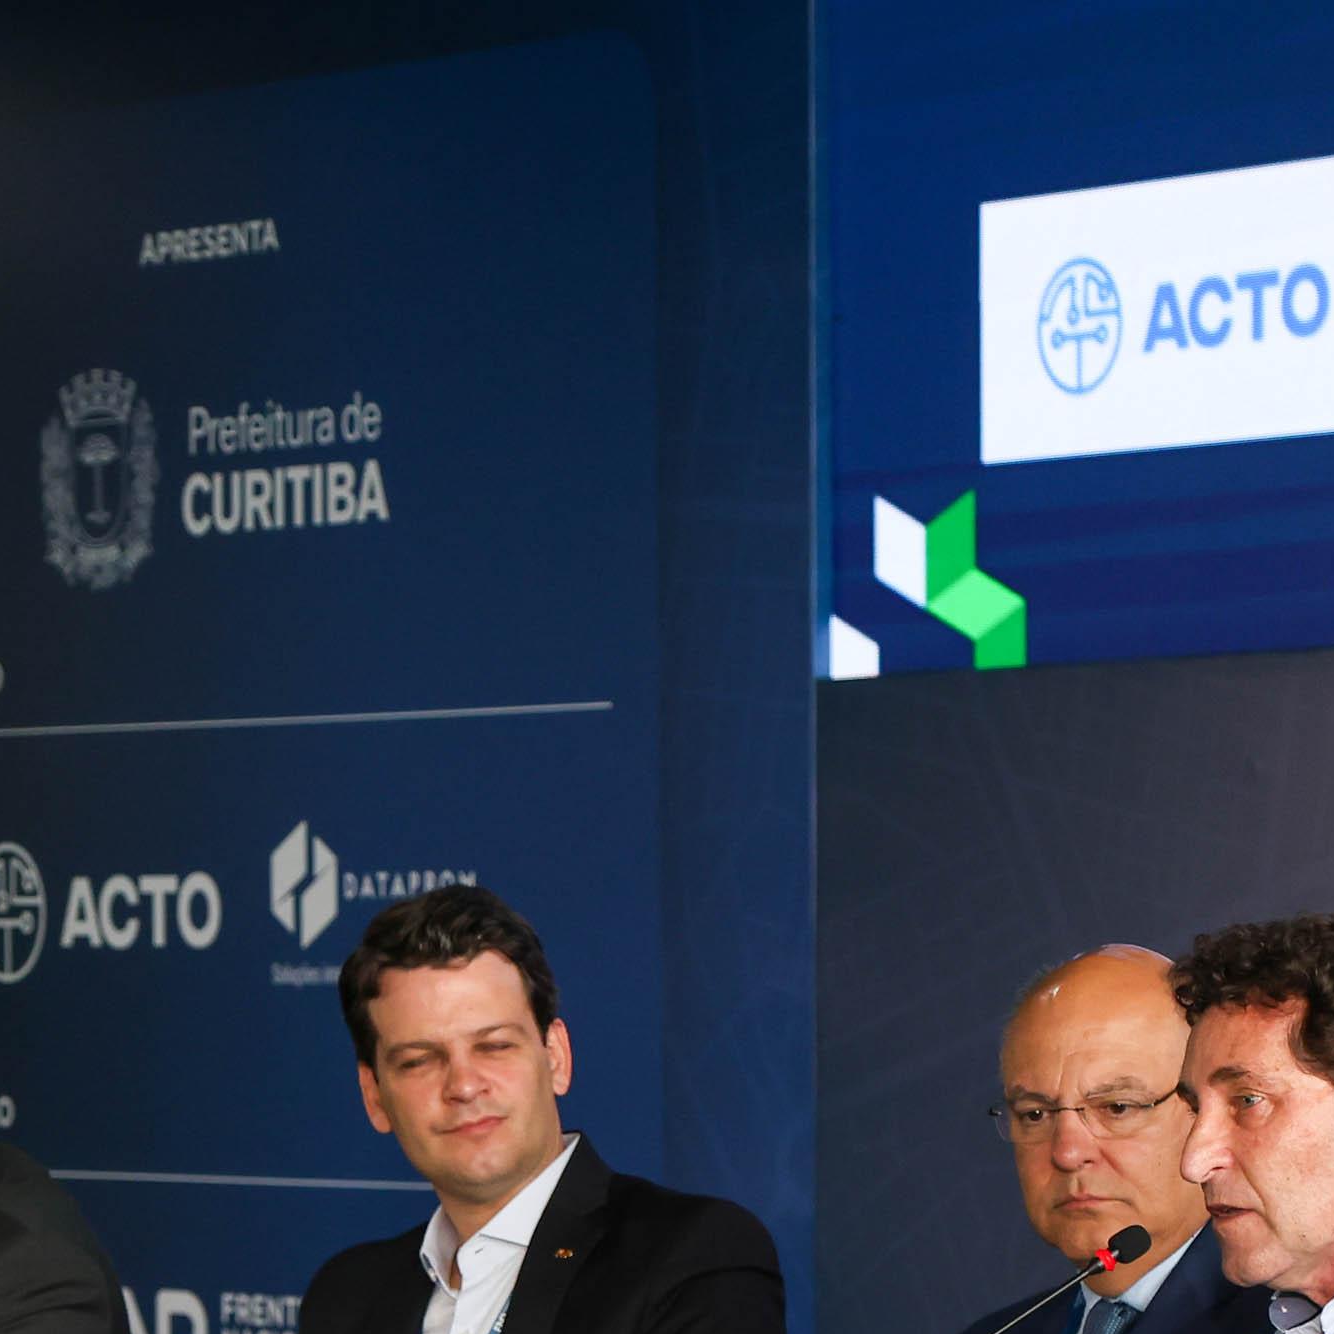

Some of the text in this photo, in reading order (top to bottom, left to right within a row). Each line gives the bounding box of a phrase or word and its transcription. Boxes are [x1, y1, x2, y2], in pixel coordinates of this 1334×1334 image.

[139, 219, 279, 267] APRESENTA
[1143, 264, 1330, 354] ACTO
[188, 392, 381, 456] Prefeitura de
[181, 459, 388, 537] CURITIBA
[61, 870, 222, 951] ACTO
[220, 1292, 304, 1327] FRENT
